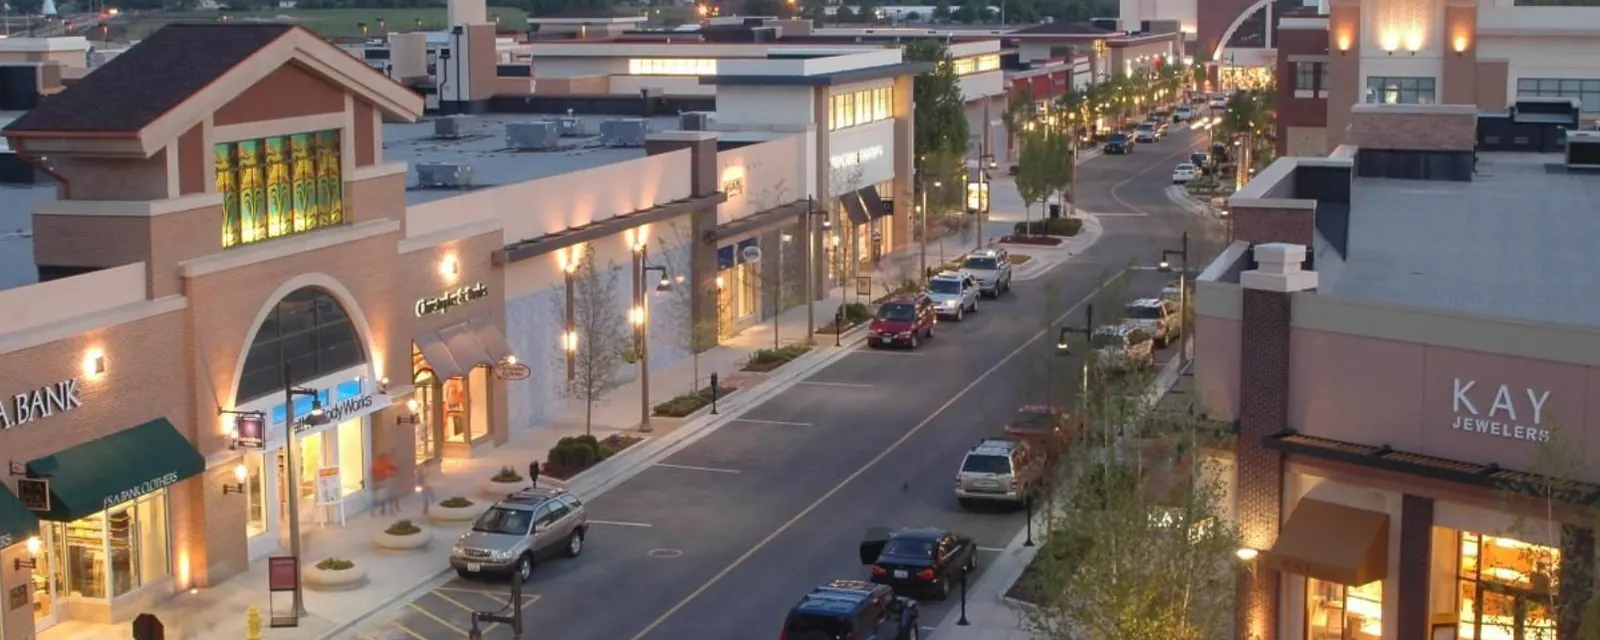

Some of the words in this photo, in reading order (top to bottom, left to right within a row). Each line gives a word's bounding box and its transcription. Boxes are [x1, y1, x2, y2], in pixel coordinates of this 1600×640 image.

[15, 378, 82, 425] BANK
[1453, 377, 1550, 425] KAY
[1452, 415, 1551, 443] JEWELERS
